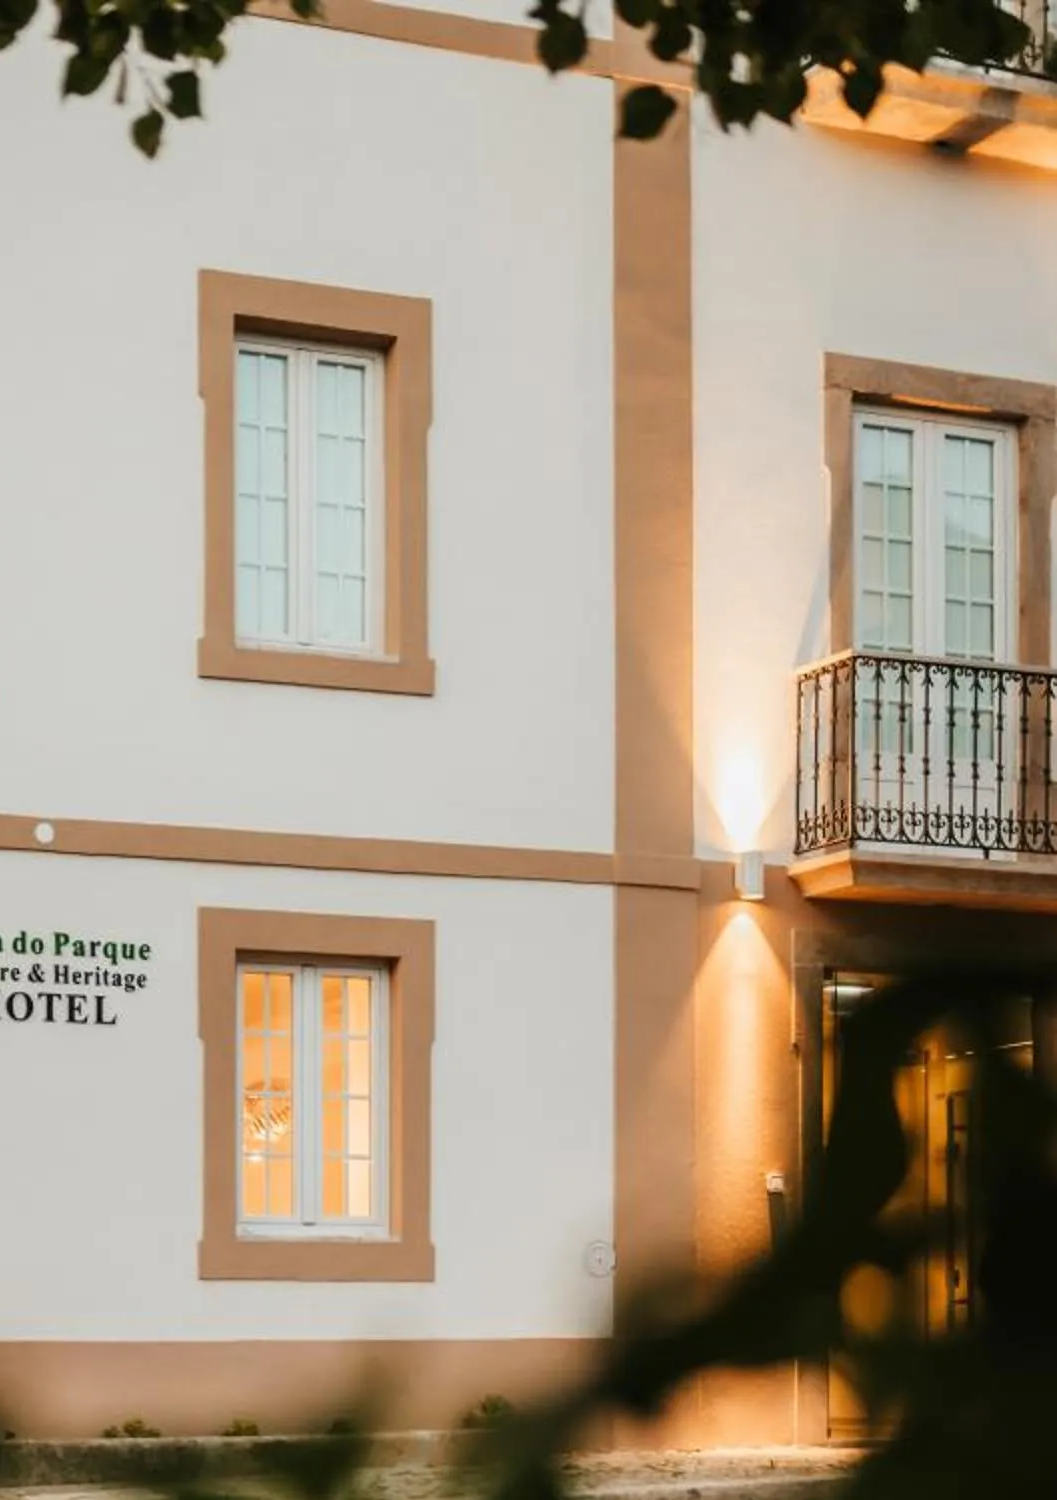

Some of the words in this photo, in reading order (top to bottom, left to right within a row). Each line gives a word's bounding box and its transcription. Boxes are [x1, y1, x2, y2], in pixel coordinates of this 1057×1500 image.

[12, 930, 44, 955] do
[53, 932, 151, 966] Parque
[27, 963, 45, 984] &
[53, 964, 147, 993] Heritage
